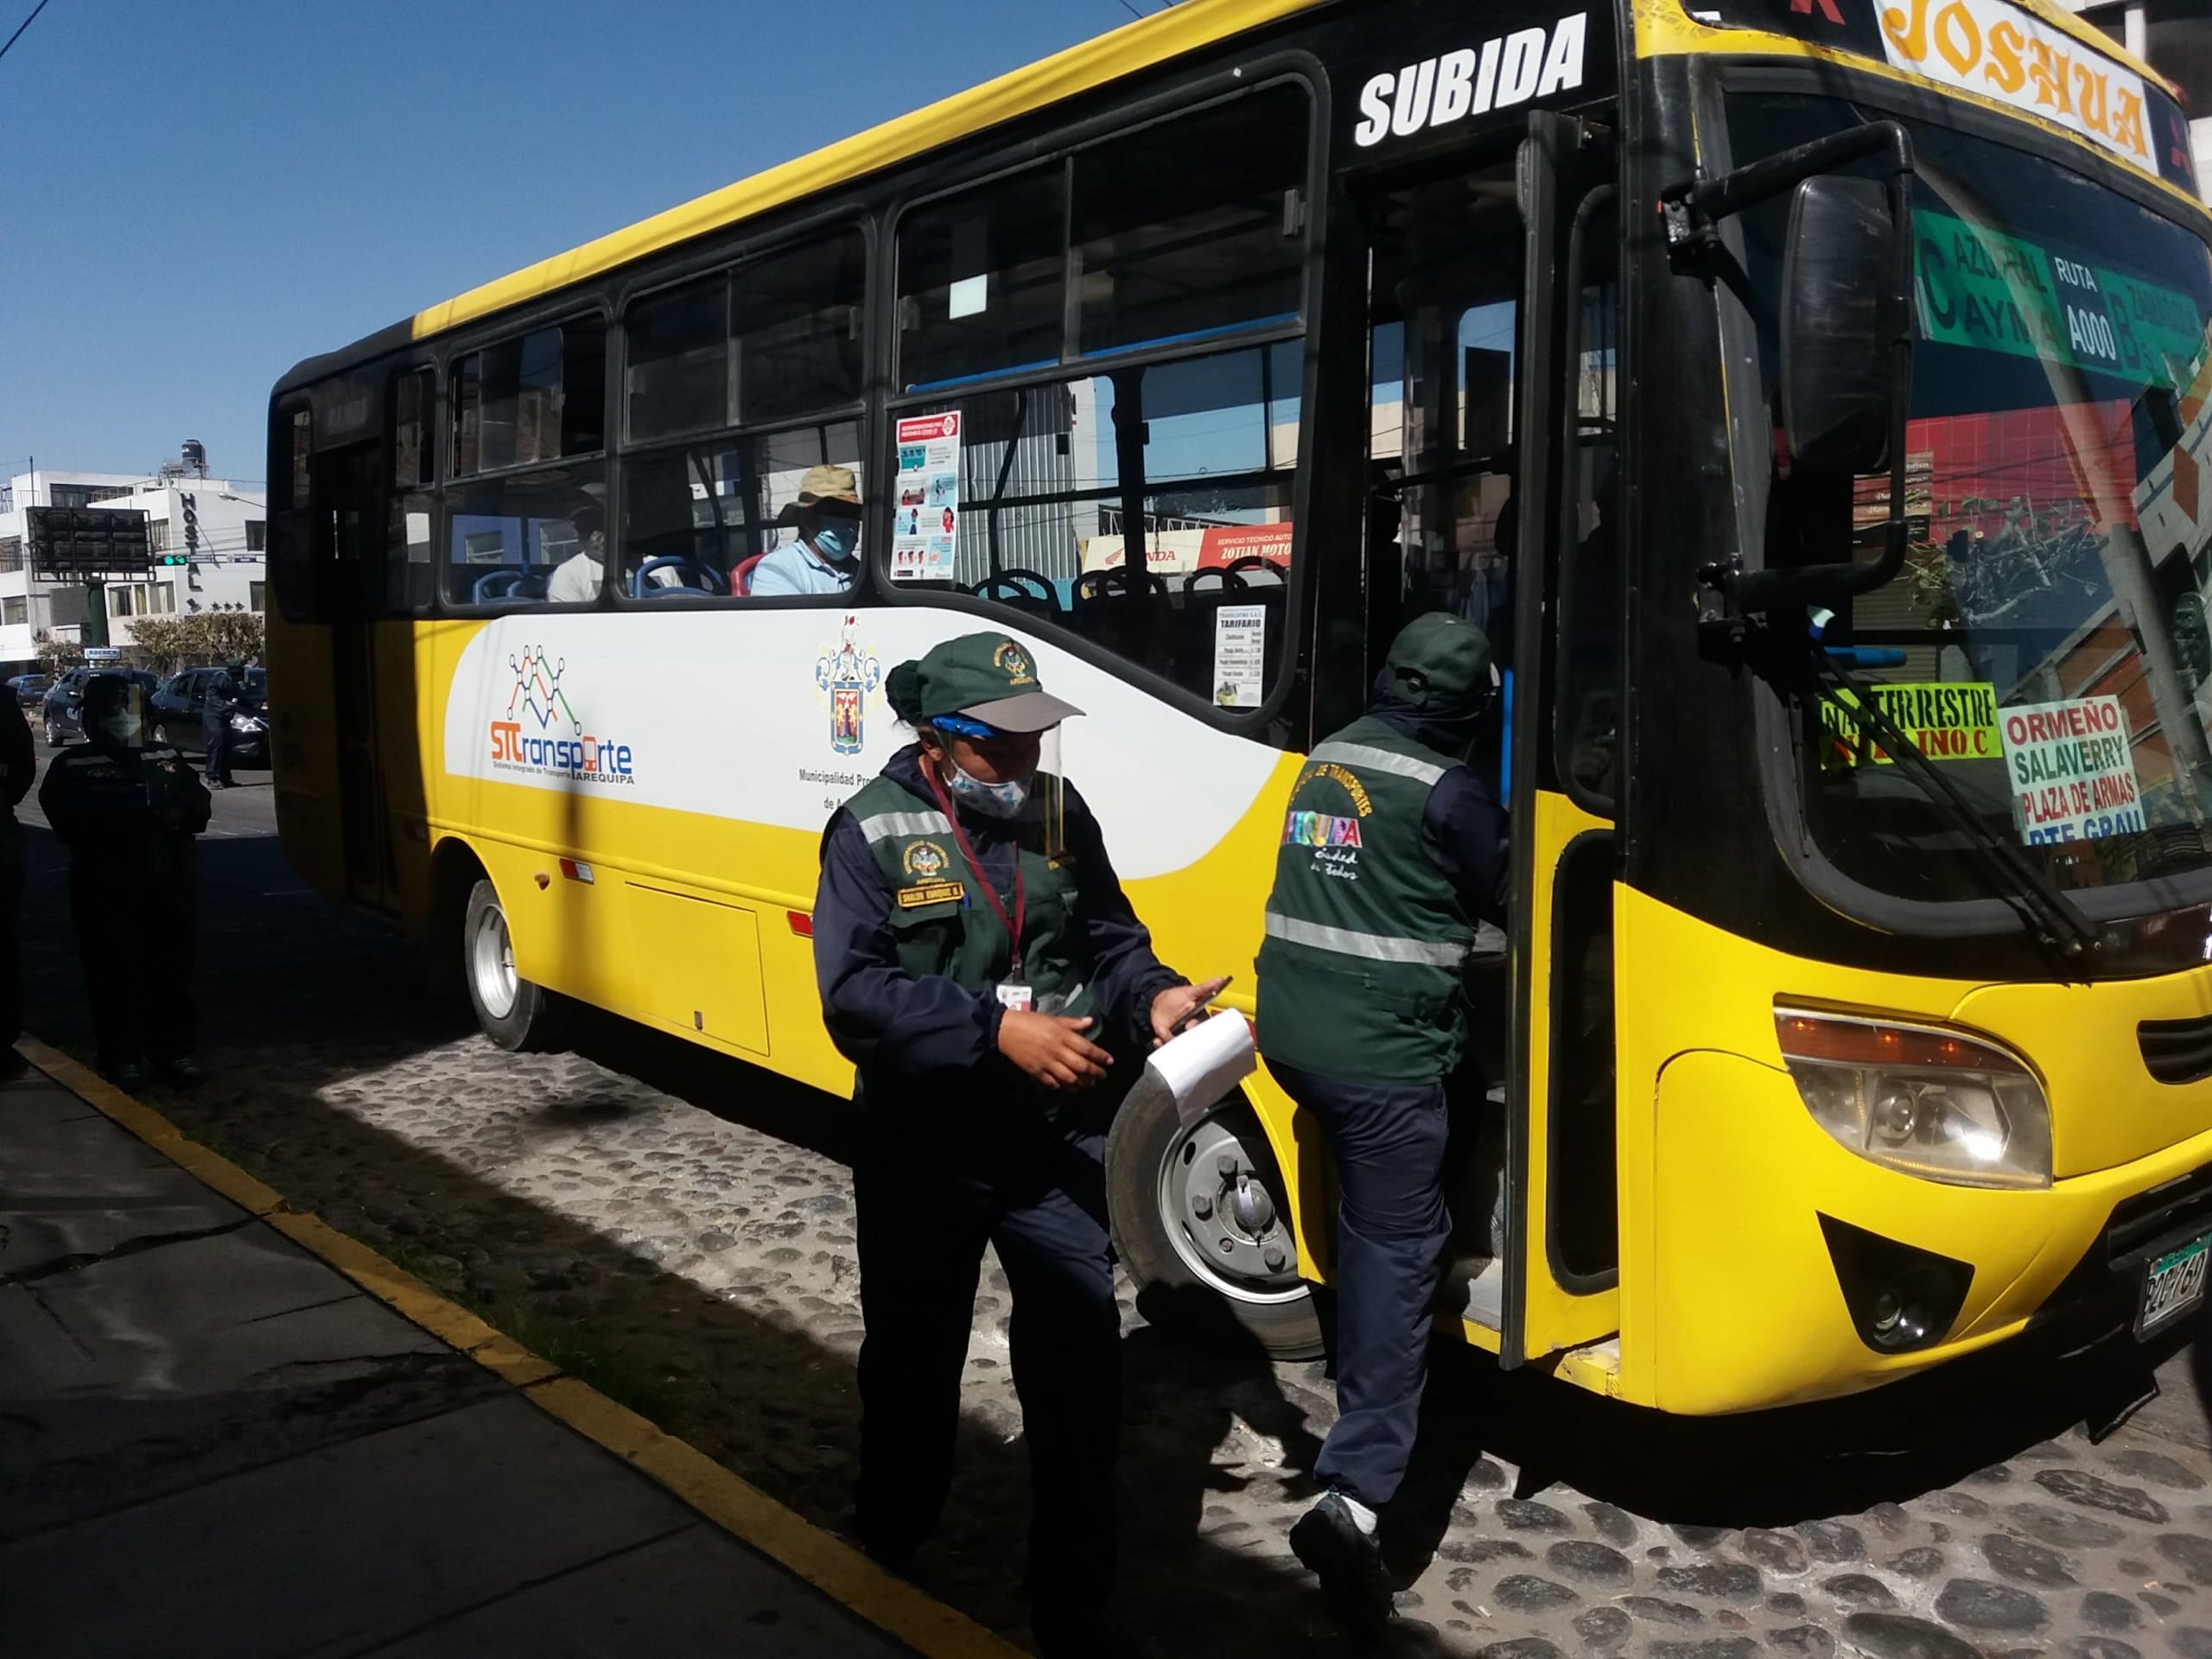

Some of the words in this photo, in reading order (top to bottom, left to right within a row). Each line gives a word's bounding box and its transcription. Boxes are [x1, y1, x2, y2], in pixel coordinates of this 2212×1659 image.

[1355, 12, 1587, 147] SUBIDA
[1882, 0, 2149, 159] JOSHUA
[2054, 256, 2098, 293] RUTA
[2067, 304, 2117, 360] A000
[180, 493, 205, 593] HOSTAL
[1146, 550, 1176, 562] NDA
[1221, 620, 1261, 628] TARIFARIO
[1868, 689, 1994, 729] TERRESTRE
[2007, 700, 2119, 746] ORMEÑO
[576, 772, 635, 785] AREQUIPA
[799, 768, 855, 785] Municipalidad
[2014, 735, 2126, 785] SALAVERRY
[823, 797, 835, 809] de
[2021, 786, 2070, 825] PLAZA
[2069, 781, 2092, 815] DE
[2092, 772, 2135, 810] ARMAS
